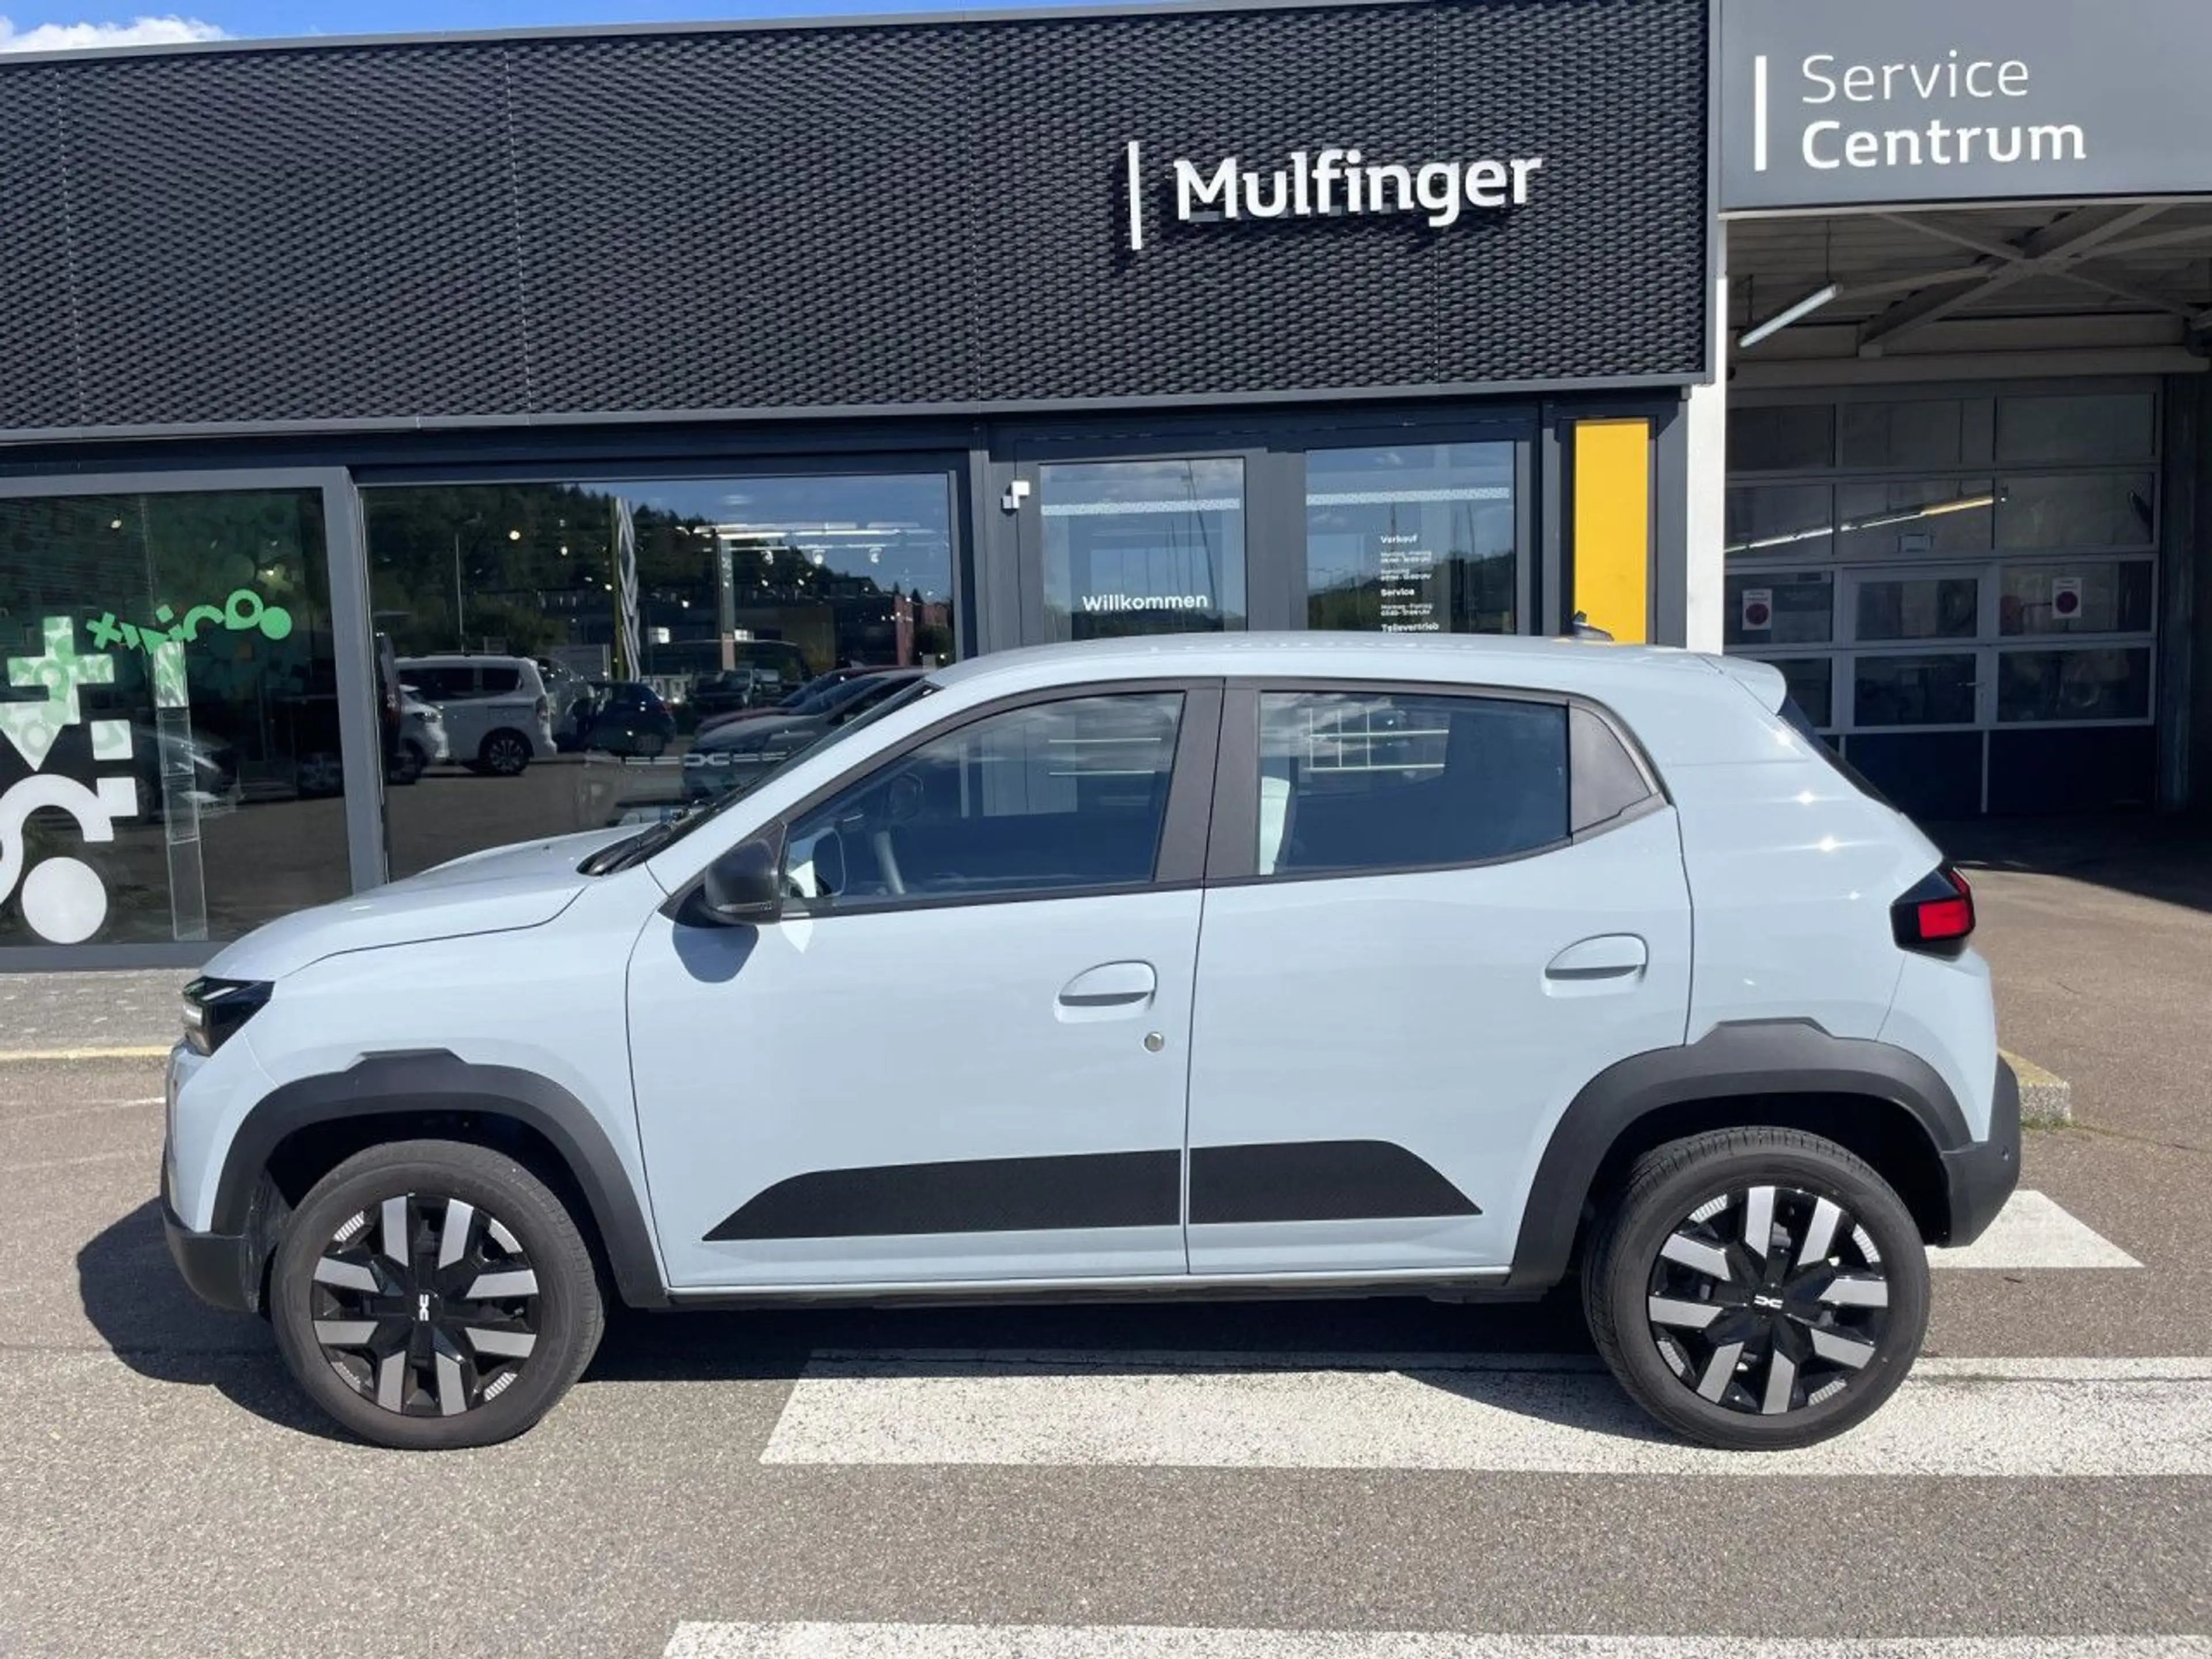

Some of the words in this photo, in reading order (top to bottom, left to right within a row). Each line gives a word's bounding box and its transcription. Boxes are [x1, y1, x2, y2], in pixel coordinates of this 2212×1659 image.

[1802, 50, 2029, 104] Service
[1802, 119, 2087, 169] Centrum
[1173, 149, 1543, 228] Mulfinger
[1380, 534, 1418, 543] Verkauf
[1082, 593, 1209, 612] Willkommen
[1381, 588, 1415, 597] Service
